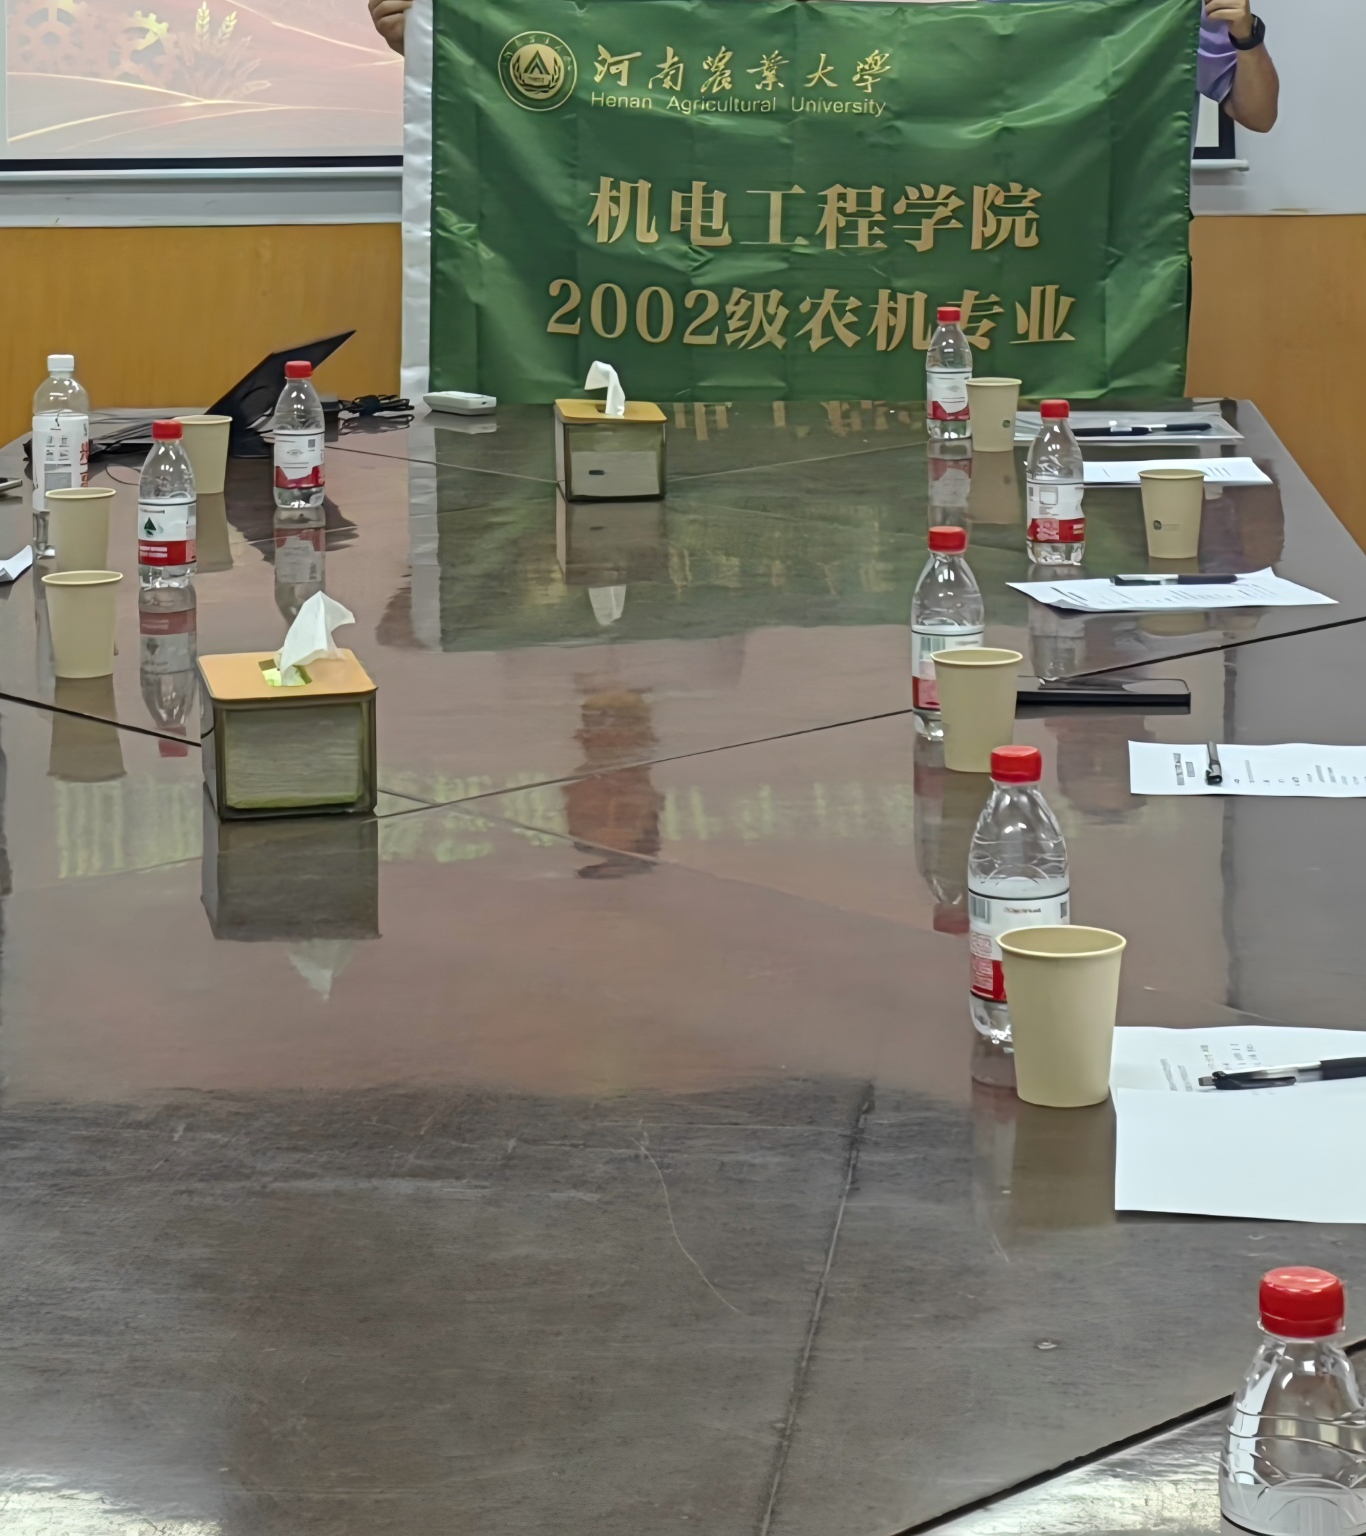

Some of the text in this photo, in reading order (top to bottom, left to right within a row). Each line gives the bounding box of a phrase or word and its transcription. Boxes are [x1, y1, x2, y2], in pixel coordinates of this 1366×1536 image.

[591, 91, 887, 118] Henan Agricultural University
[587, 175, 1043, 253] 机电工程学院
[546, 278, 1077, 353] 2002级农机专业
